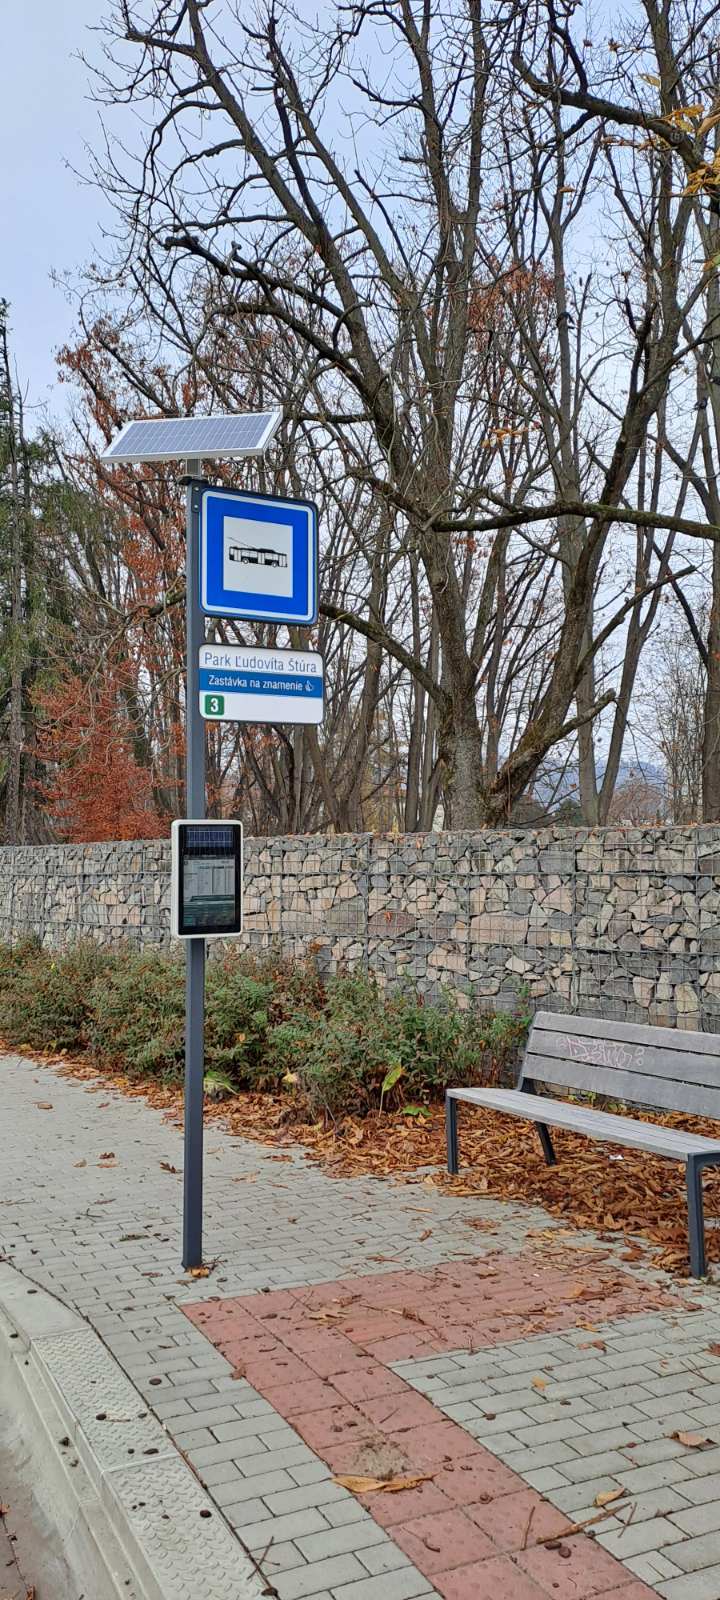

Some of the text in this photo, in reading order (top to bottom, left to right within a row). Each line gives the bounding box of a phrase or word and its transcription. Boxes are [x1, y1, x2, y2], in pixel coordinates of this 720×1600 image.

[204, 652, 317, 673] Park Ľudovíta Štúra
[208, 674, 303, 691] Zastávka na znamenie
[210, 697, 219, 713] 3
